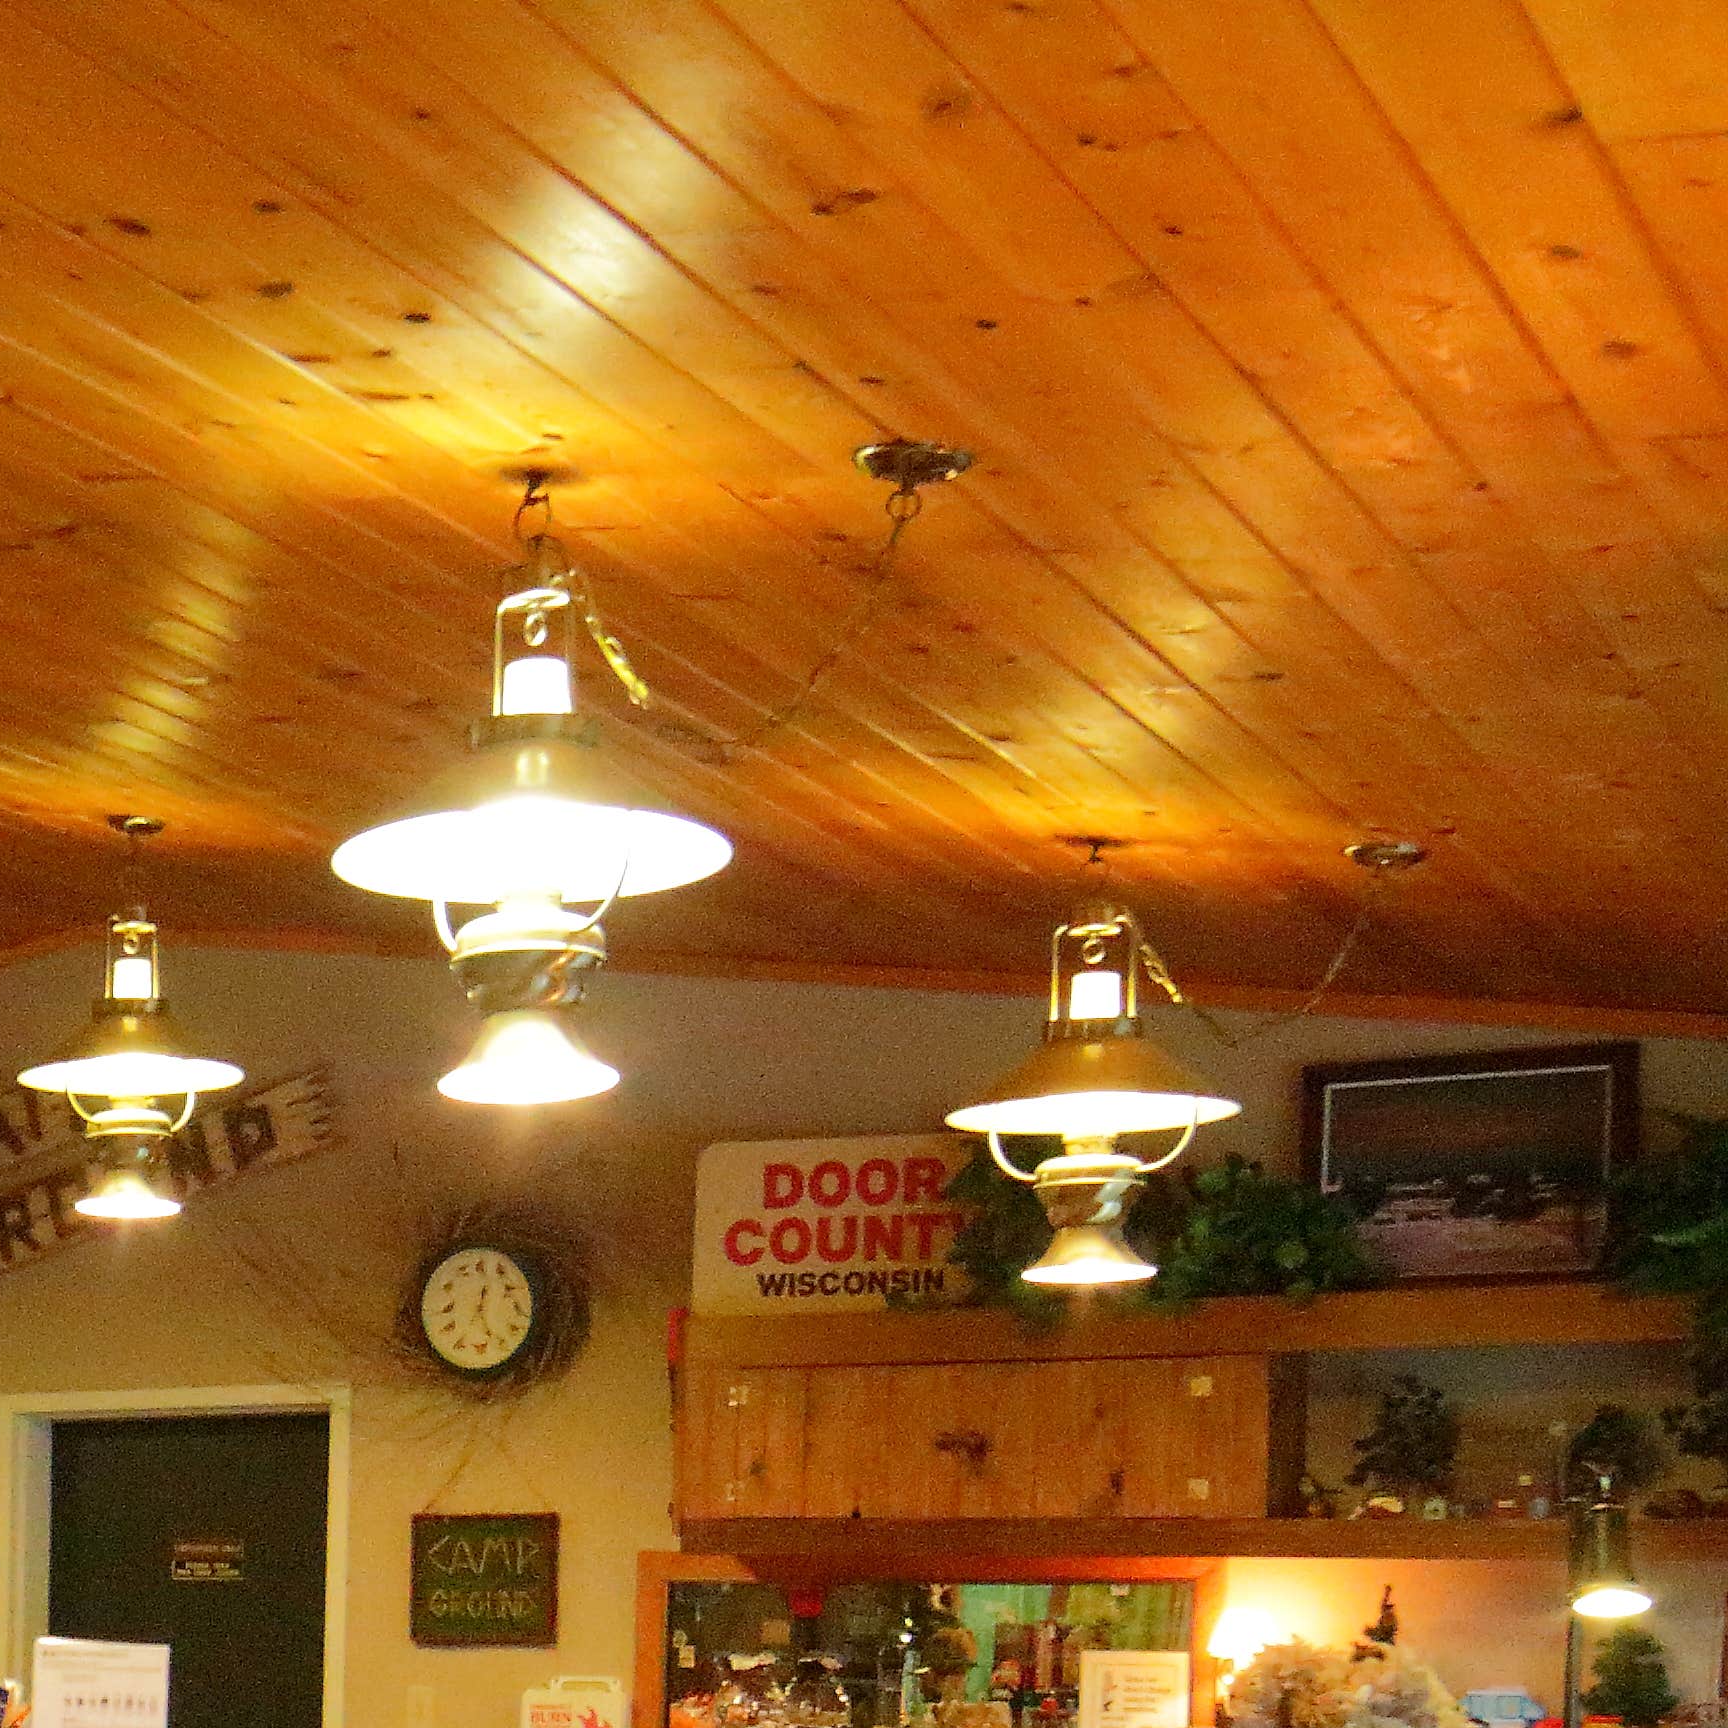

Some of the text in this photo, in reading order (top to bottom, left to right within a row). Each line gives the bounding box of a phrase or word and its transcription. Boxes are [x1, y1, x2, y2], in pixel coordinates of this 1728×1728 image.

[763, 1156, 946, 1210] DOOR
[755, 1268, 945, 1298] WISCONSIN
[428, 1535, 540, 1575] CAMP
